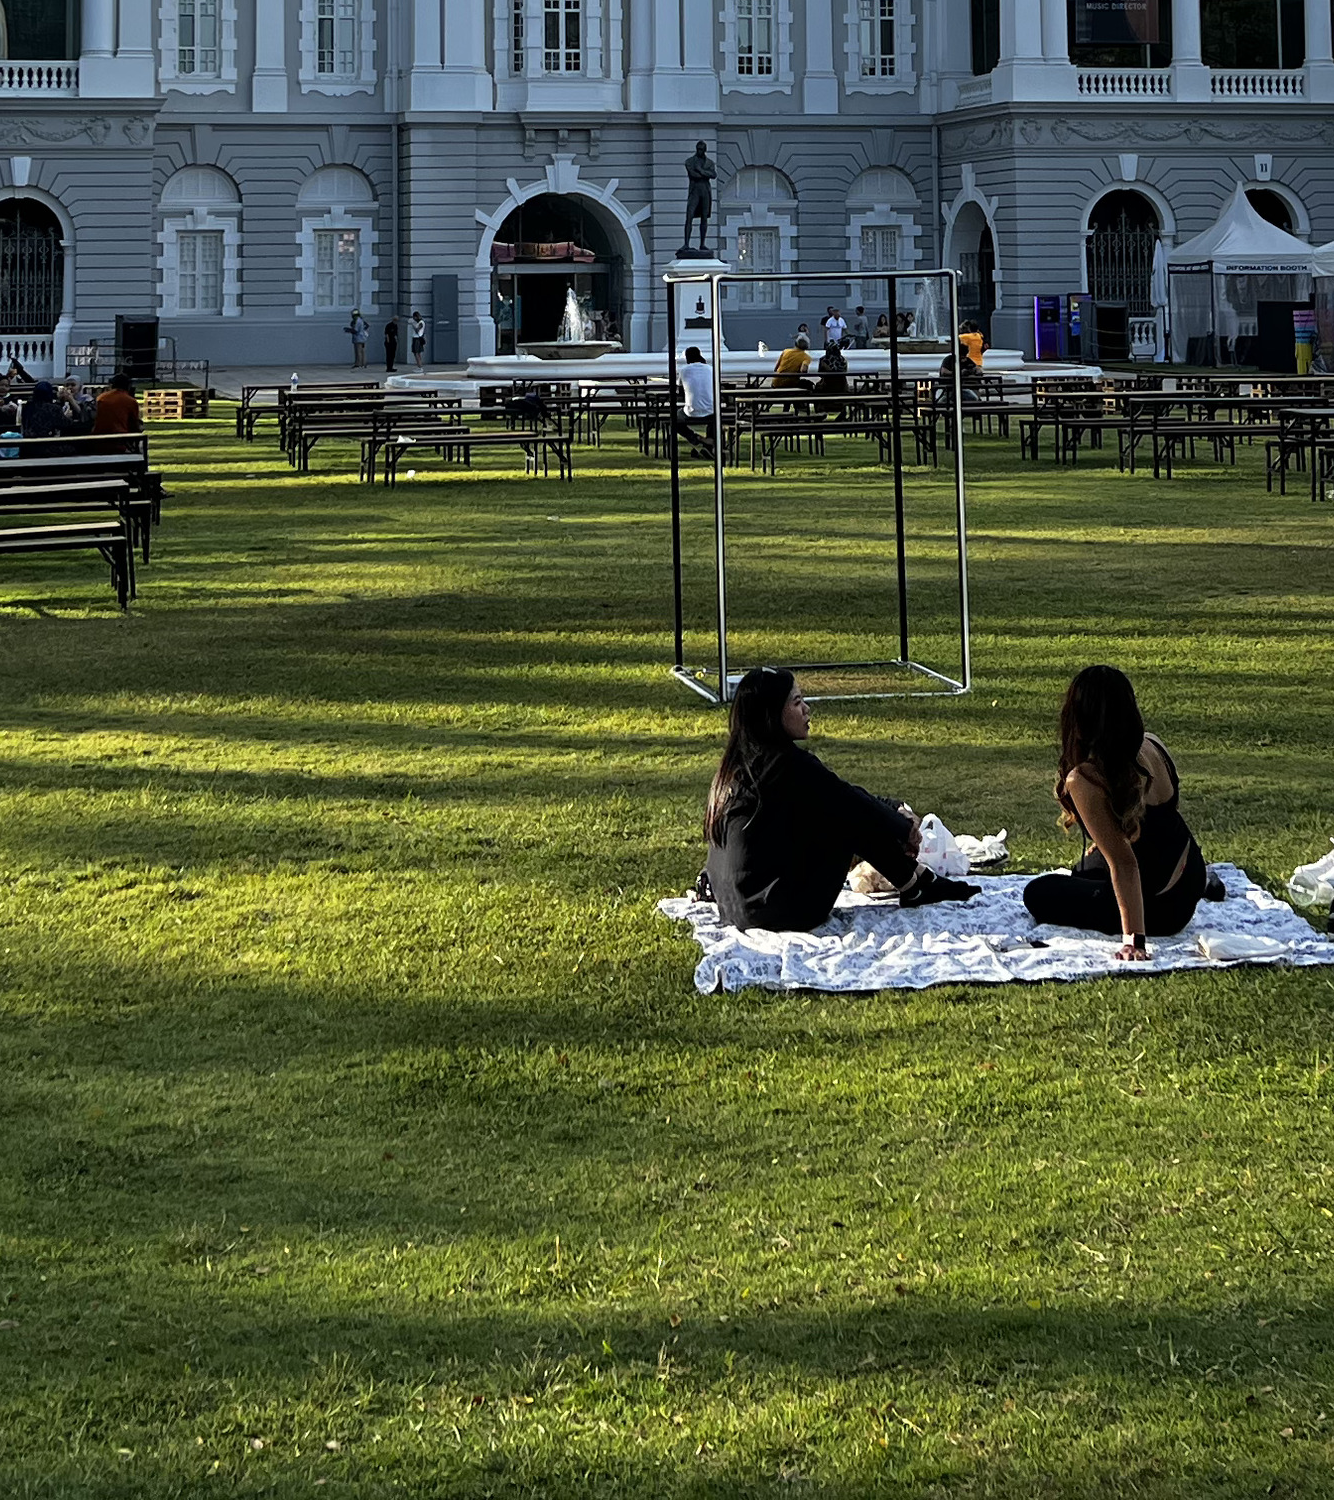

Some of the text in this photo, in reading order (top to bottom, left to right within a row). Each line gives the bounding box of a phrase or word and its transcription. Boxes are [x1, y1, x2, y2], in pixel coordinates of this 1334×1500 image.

[1086, 2, 1147, 10] MUSIC DIRECTOR
[1260, 163, 1268, 172] 11
